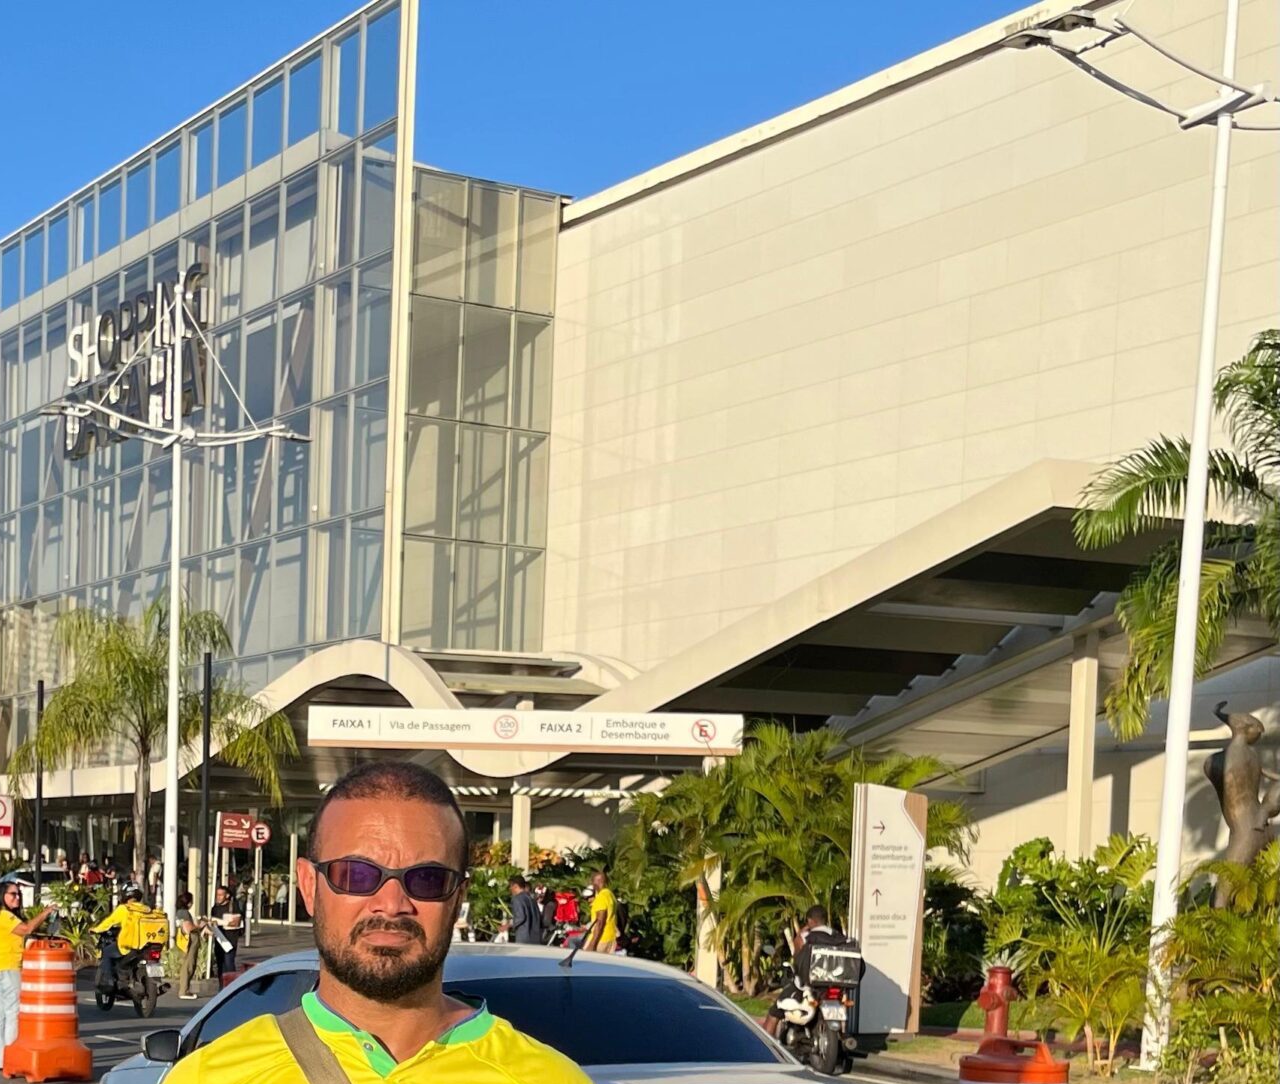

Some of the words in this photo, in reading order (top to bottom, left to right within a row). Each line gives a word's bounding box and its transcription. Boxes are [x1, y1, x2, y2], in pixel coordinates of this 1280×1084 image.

[331, 719, 364, 729] FAIXA
[367, 720, 372, 729] 1
[389, 720, 405, 730] Via
[408, 720, 420, 730] de
[422, 721, 471, 732] Passagem
[540, 723, 572, 733] FAIXA
[576, 724, 582, 733] 2
[605, 719, 657, 730] Embarque
[600, 730, 670, 741] Desembarque
